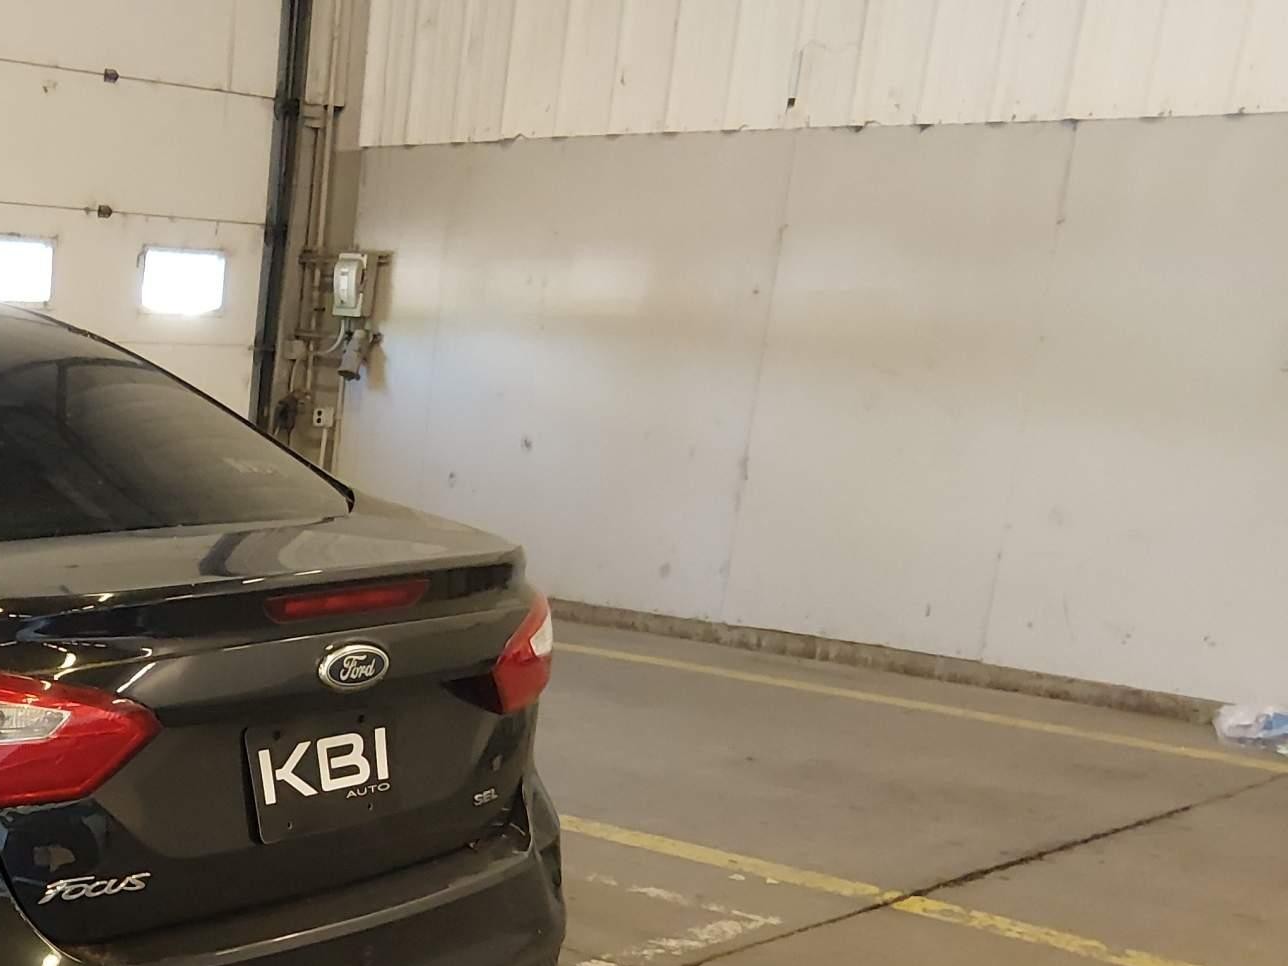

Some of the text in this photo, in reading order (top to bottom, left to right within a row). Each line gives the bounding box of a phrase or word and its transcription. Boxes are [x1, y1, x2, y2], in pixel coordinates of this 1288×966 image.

[339, 654, 376, 682] Ford
[258, 727, 389, 805] KBI
[346, 782, 391, 799] AUTO
[473, 788, 499, 806] SEL
